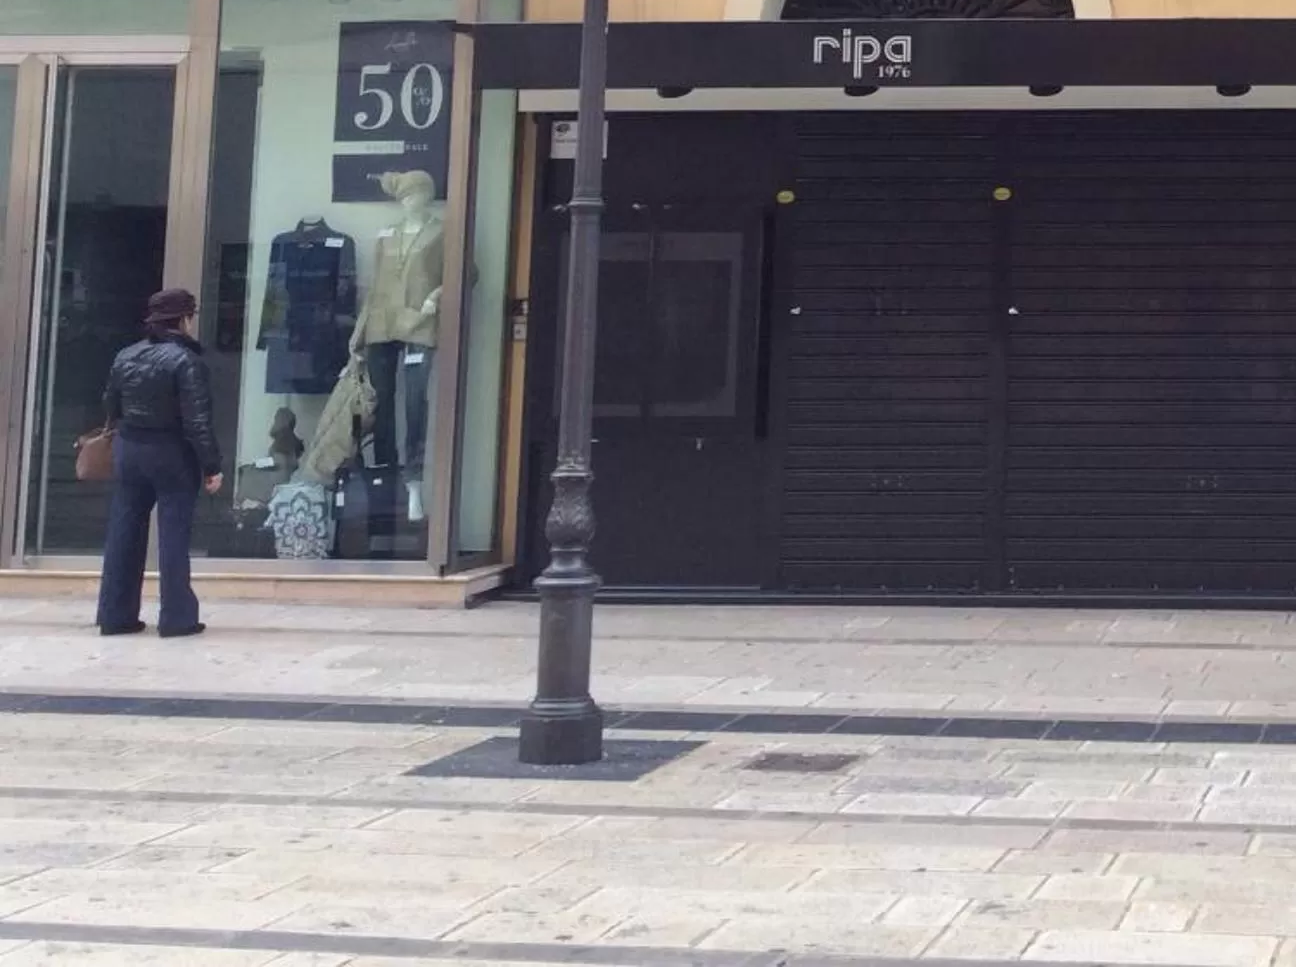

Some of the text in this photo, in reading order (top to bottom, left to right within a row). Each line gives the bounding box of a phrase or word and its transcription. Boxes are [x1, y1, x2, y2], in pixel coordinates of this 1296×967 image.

[813, 28, 912, 79] ripa
[878, 65, 911, 78] 1976
[354, 62, 443, 130] 50
